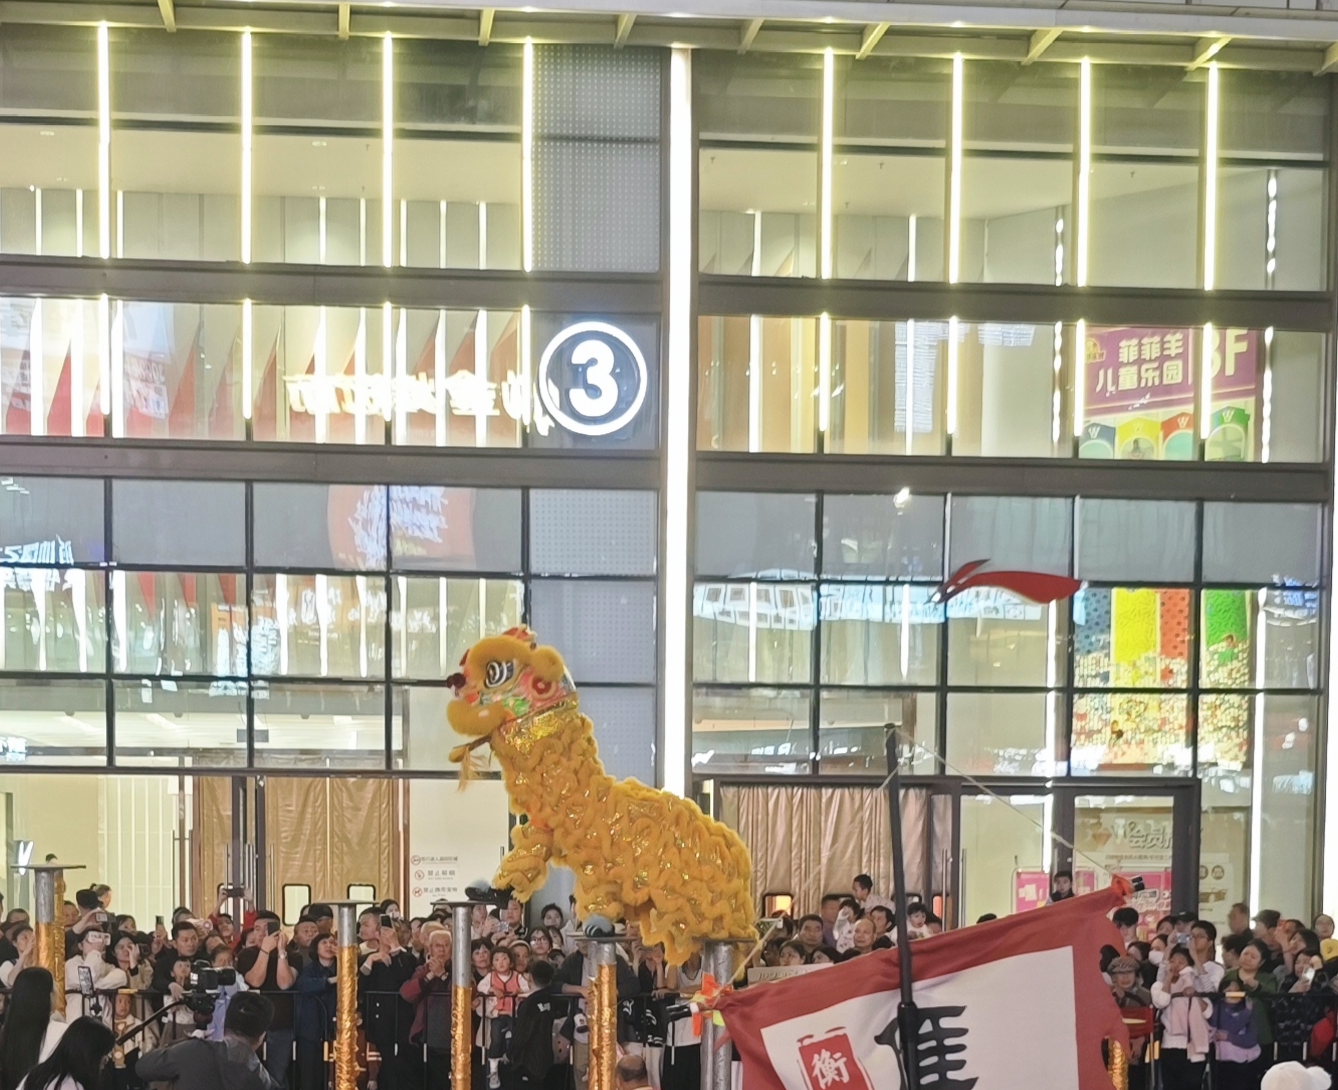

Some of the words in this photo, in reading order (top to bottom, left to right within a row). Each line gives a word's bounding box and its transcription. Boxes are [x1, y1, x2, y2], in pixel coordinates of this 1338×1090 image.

[1118, 331, 1184, 364] 菲菲羊
[568, 339, 619, 418] 3
[1095, 359, 1184, 393] 儿童乐园
